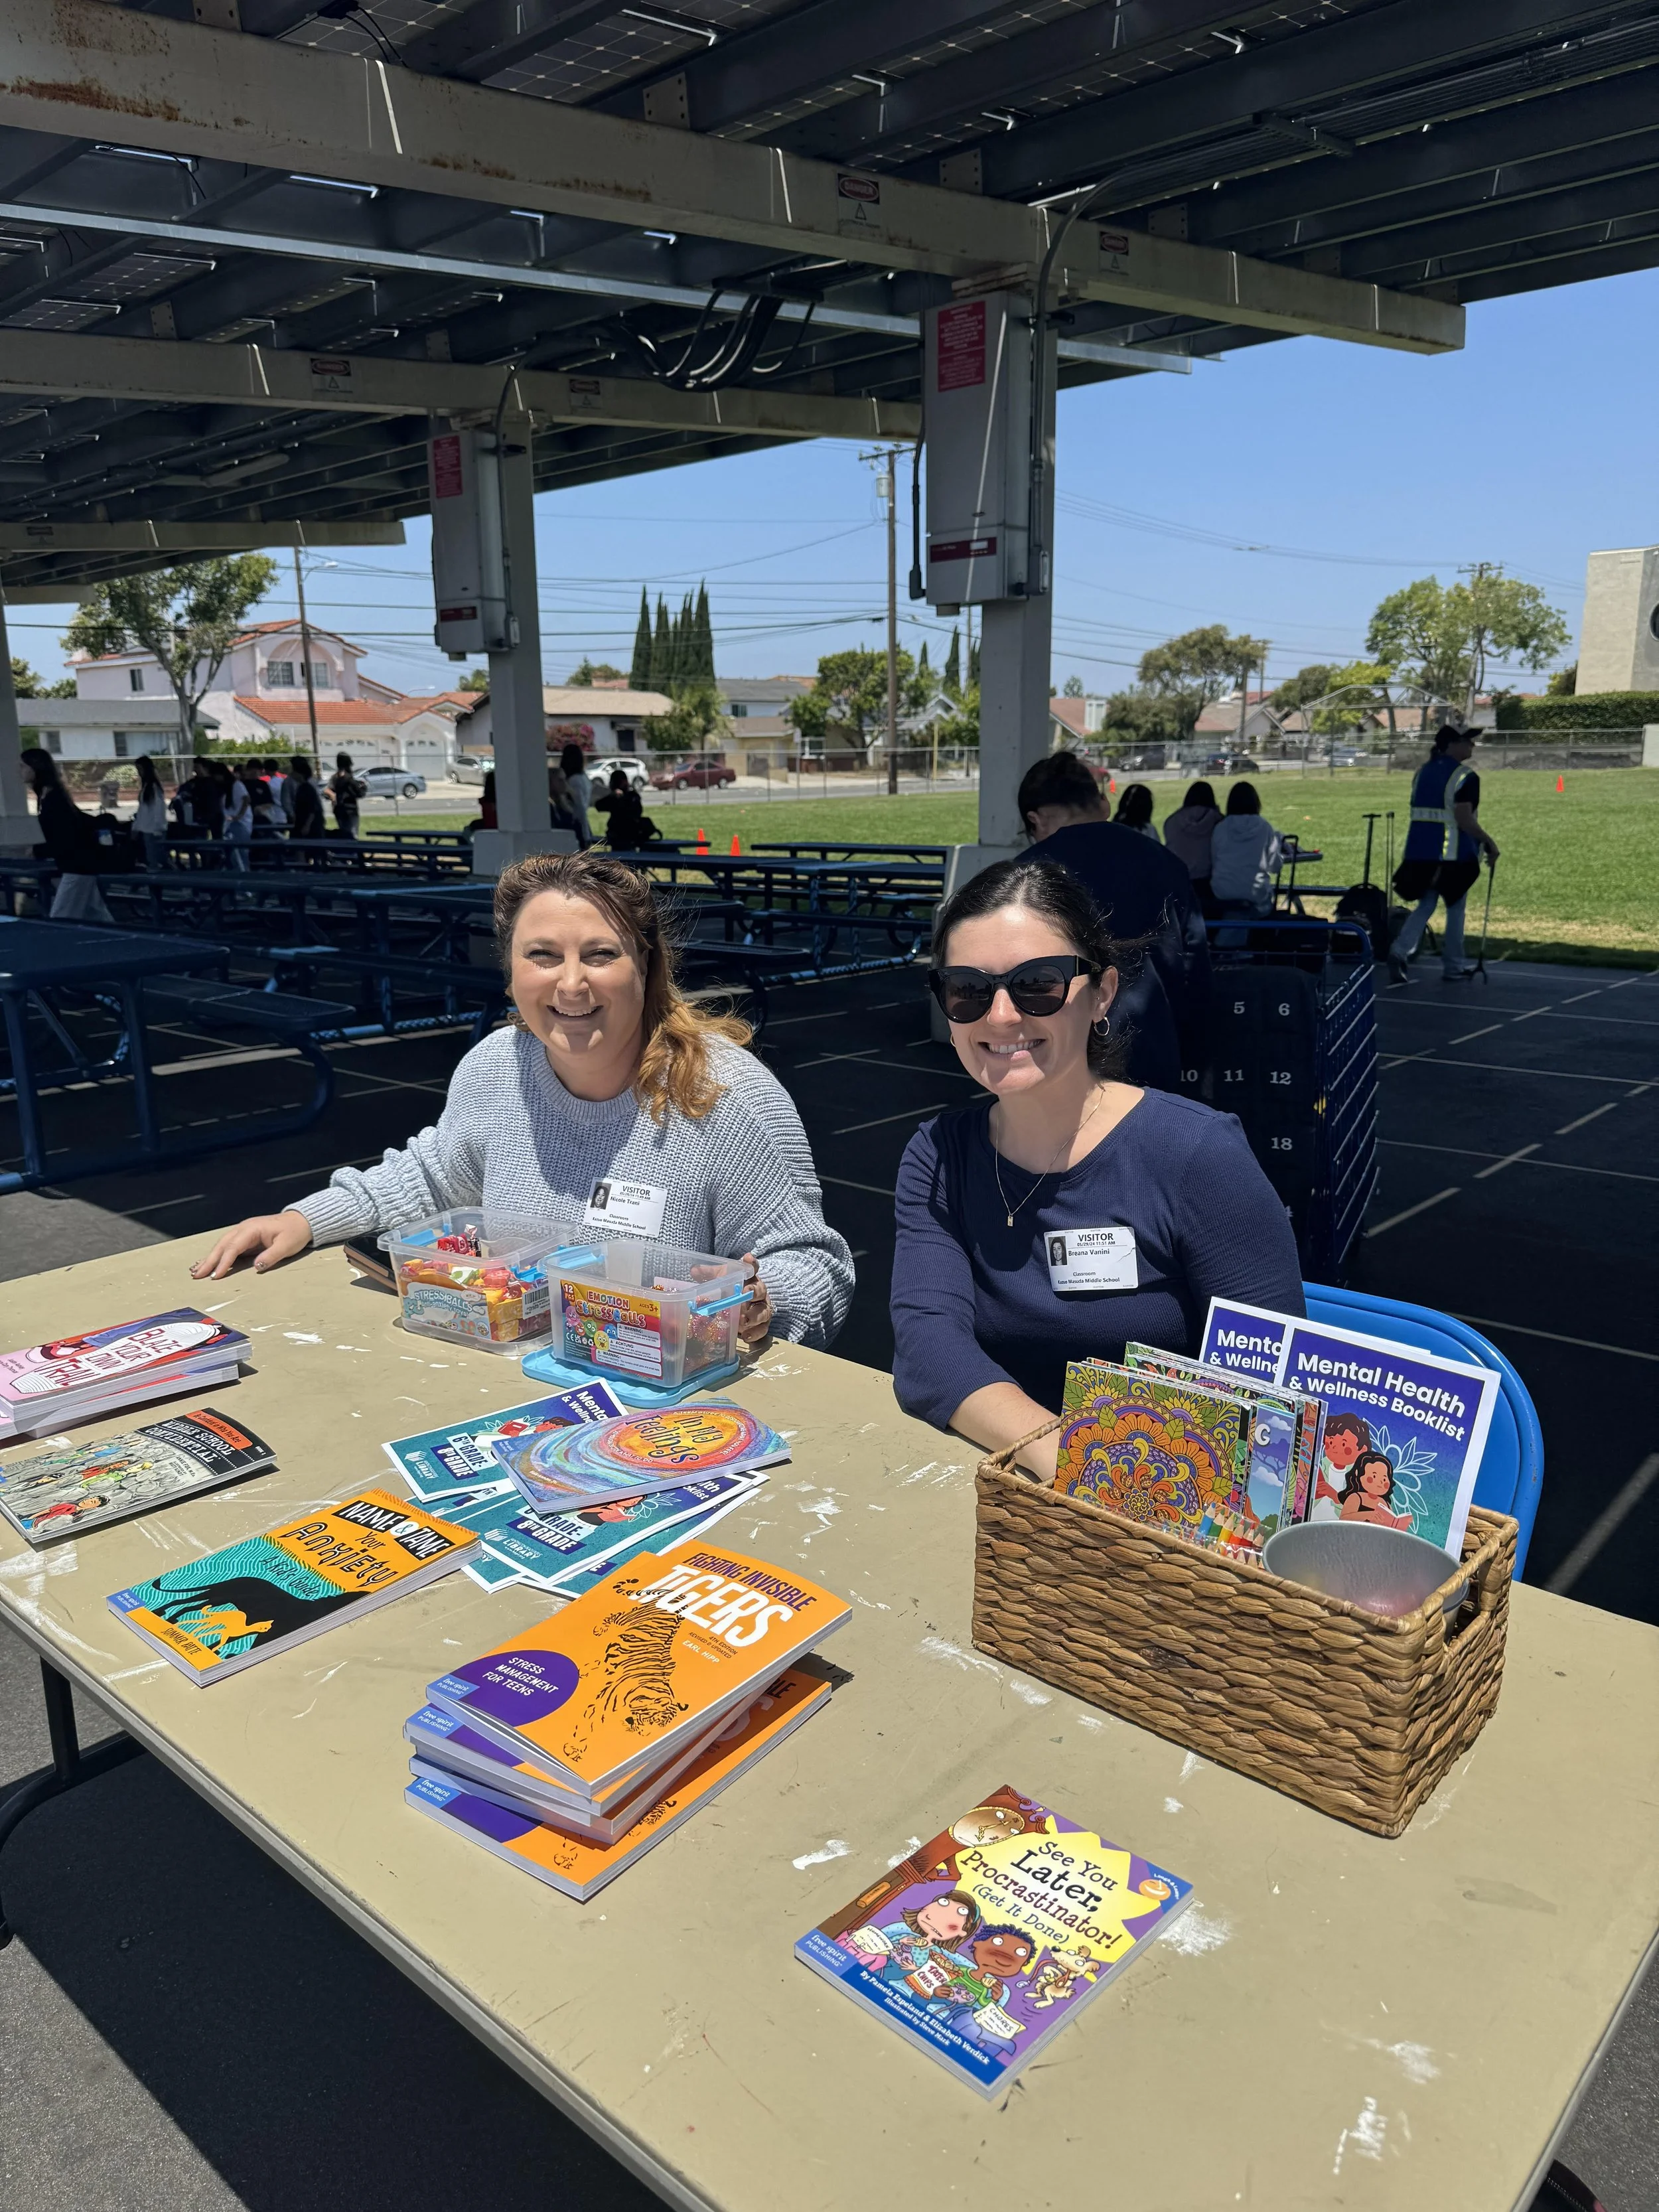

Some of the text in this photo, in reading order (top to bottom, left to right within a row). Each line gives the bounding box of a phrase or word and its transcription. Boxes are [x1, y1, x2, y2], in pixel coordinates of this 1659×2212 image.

[1234, 1001, 1291, 1016] 5 6
[1181, 1069, 1292, 1085] 10 11 12
[1271, 1137, 1293, 1150] 18
[622, 1185, 650, 1197] VISITOR
[1078, 1233, 1114, 1242] VISITOR
[564, 1284, 574, 1293] 12
[587, 1290, 630, 1309] EMOTION
[414, 1290, 473, 1312] STRESS BALLS
[575, 1299, 646, 1327] Stress Balls
[111, 1342, 152, 1362] YOUR
[128, 1328, 184, 1354] BLAZE
[1217, 1329, 1281, 1357] Menta
[33, 1358, 101, 1386] TRAIL
[85, 1353, 125, 1370] OWN
[1210, 1352, 1279, 1374] & Wellne
[1297, 1352, 1466, 1419] Mental Health
[569, 1400, 593, 1424] Wellne
[576, 1390, 609, 1420] Menta
[1289, 1376, 1466, 1442] & Wellness Booklist
[161, 1421, 236, 1455] MIDDLE SCHOOL
[625, 1414, 701, 1464] Feelings
[674, 1415, 725, 1443] In My
[145, 1427, 219, 1463] CONFIDENTIAL
[415, 1461, 435, 1479] LIBRARY
[444, 1455, 474, 1477] GRADE
[339, 1502, 406, 1531] NAME
[355, 1531, 386, 1550] Your
[398, 1524, 415, 1535] &
[534, 1527, 578, 1551] GRADE
[279, 1521, 399, 1588] Anxiety
[399, 1527, 451, 1558] TAME
[502, 1539, 543, 1559] LIBRARY
[266, 1561, 298, 1581] Kid's
[289, 1576, 321, 1597] Guide
[682, 1552, 818, 1612] FIGHTING INVISIBLE
[628, 1564, 794, 1647] TIGERS
[161, 1627, 186, 1645] SUMMER
[688, 1632, 709, 1644] REVISED
[711, 1643, 732, 1659] UPDATED
[709, 1635, 738, 1656] 4TH EDITION
[682, 1640, 720, 1663] EARL HIPP
[508, 1657, 545, 1674] STRESS
[443, 1678, 469, 1692] free spirit
[482, 1672, 535, 1696] FOR TEENS
[495, 1664, 559, 1693] MANAGEMENT
[423, 1710, 455, 1728] free spirit
[421, 1779, 451, 1798] free spirit
[1039, 1842, 1118, 1891] See You
[1010, 1850, 1104, 1913] Later,
[960, 1850, 1123, 1949] Procrastinator!
[972, 1883, 1071, 1945] (Get It Done)
[811, 1934, 847, 1962] free spirit
[917, 1971, 934, 1989] CHIPS
[928, 1964, 948, 1984] TATER
[860, 1970, 991, 2065] By Pamela Espeland & Elizabeth Verdick
[884, 1997, 950, 2046] Illustrated by Steve Mark
[989, 2008, 1014, 2032] CHORES
